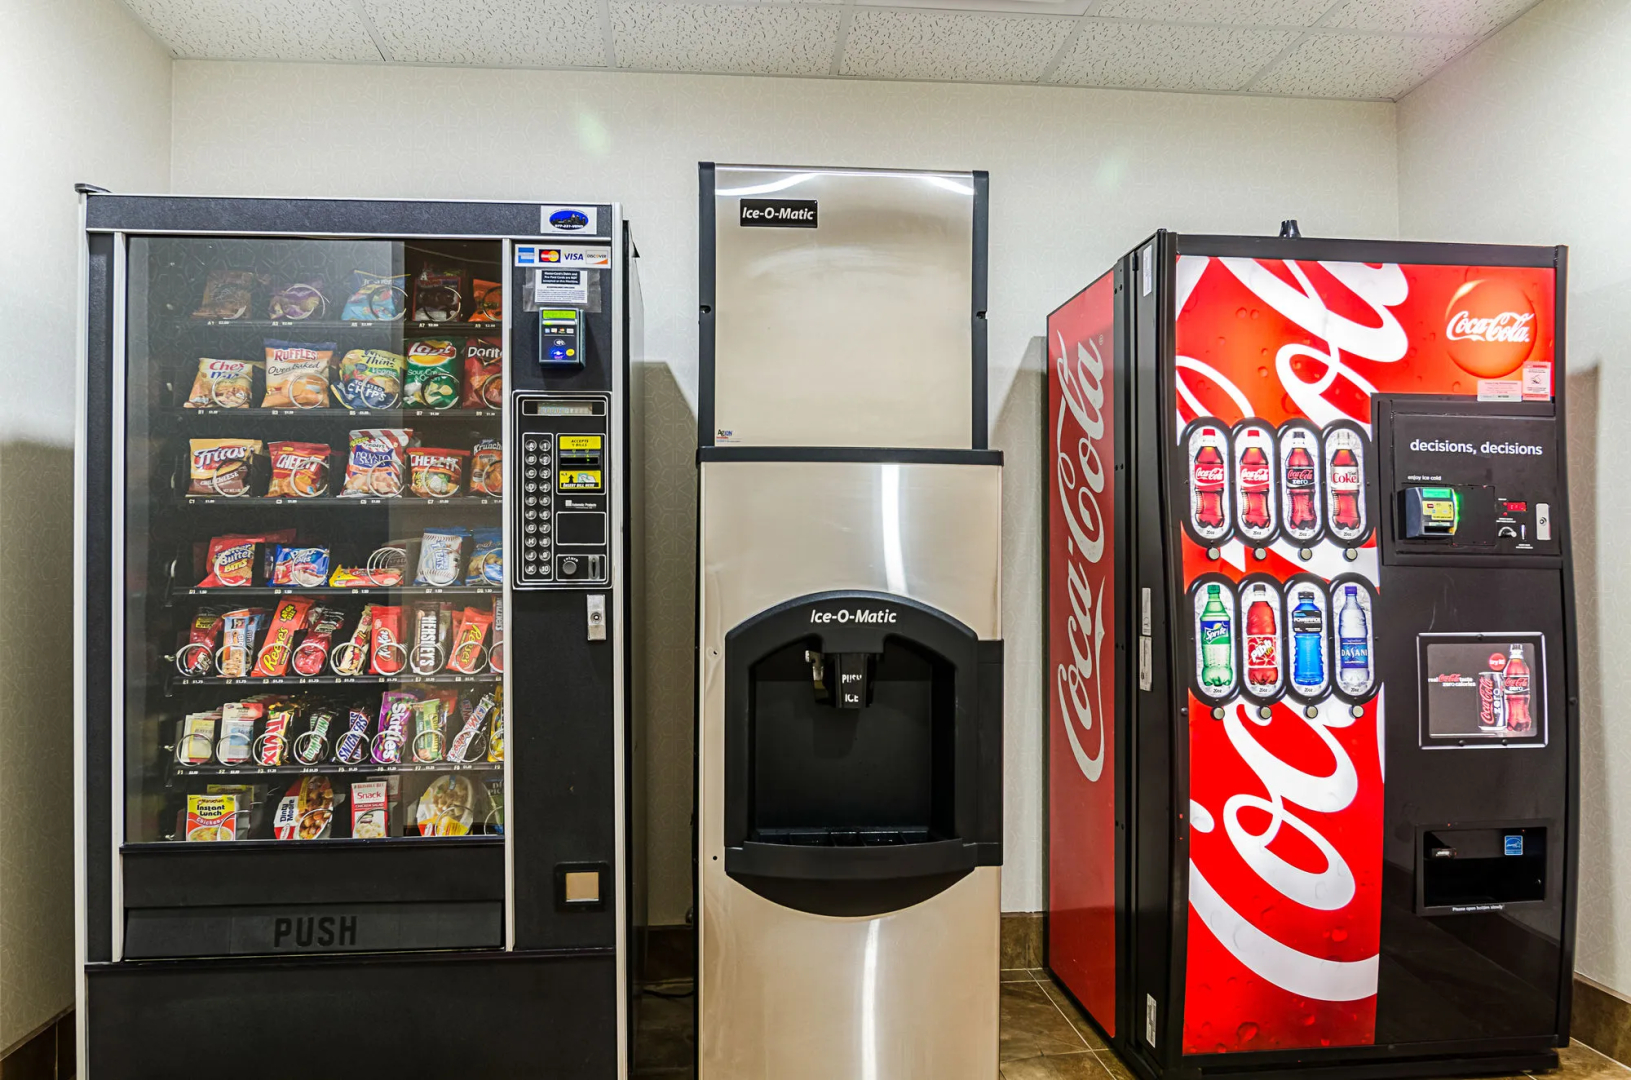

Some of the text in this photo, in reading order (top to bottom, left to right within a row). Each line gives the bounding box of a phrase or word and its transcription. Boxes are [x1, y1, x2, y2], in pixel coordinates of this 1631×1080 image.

[742, 206, 814, 220] Ice-O-Matic
[564, 253, 583, 261] VISA
[274, 349, 317, 361] RUFFLES
[467, 346, 503, 358] Dorit
[1410, 439, 1543, 455] decisions, decisions
[194, 447, 246, 468] Fritos
[1332, 473, 1357, 483] Coke
[1057, 330, 1105, 782] Coca-Cola
[810, 610, 896, 623] Ice-O-Matic
[1342, 648, 1368, 658] DASANI
[263, 715, 285, 765] TWIX
[357, 791, 381, 799] Snack
[197, 804, 224, 812] Instant
[280, 804, 288, 822] Dinty
[273, 916, 357, 947] PUSH
